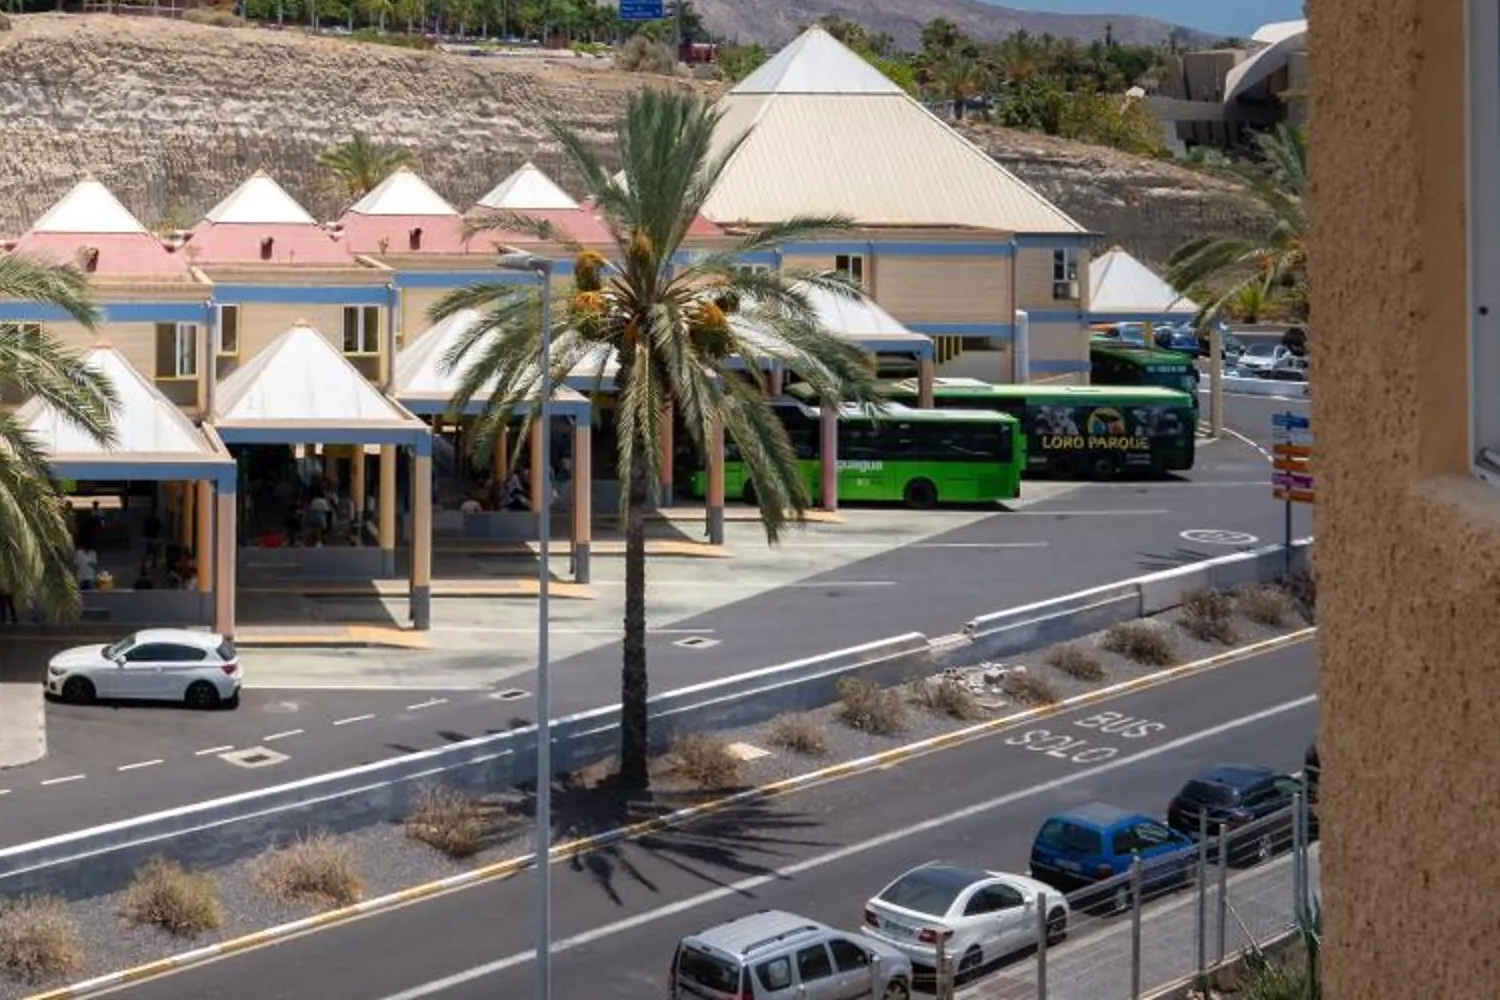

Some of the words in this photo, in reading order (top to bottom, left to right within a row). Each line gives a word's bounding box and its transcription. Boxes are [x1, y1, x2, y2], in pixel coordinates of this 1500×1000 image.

[1042, 435, 1085, 449] LORO
[1088, 436, 1150, 450] PARQUE
[1073, 711, 1167, 738] BUS
[1005, 730, 1119, 763] SOLO
